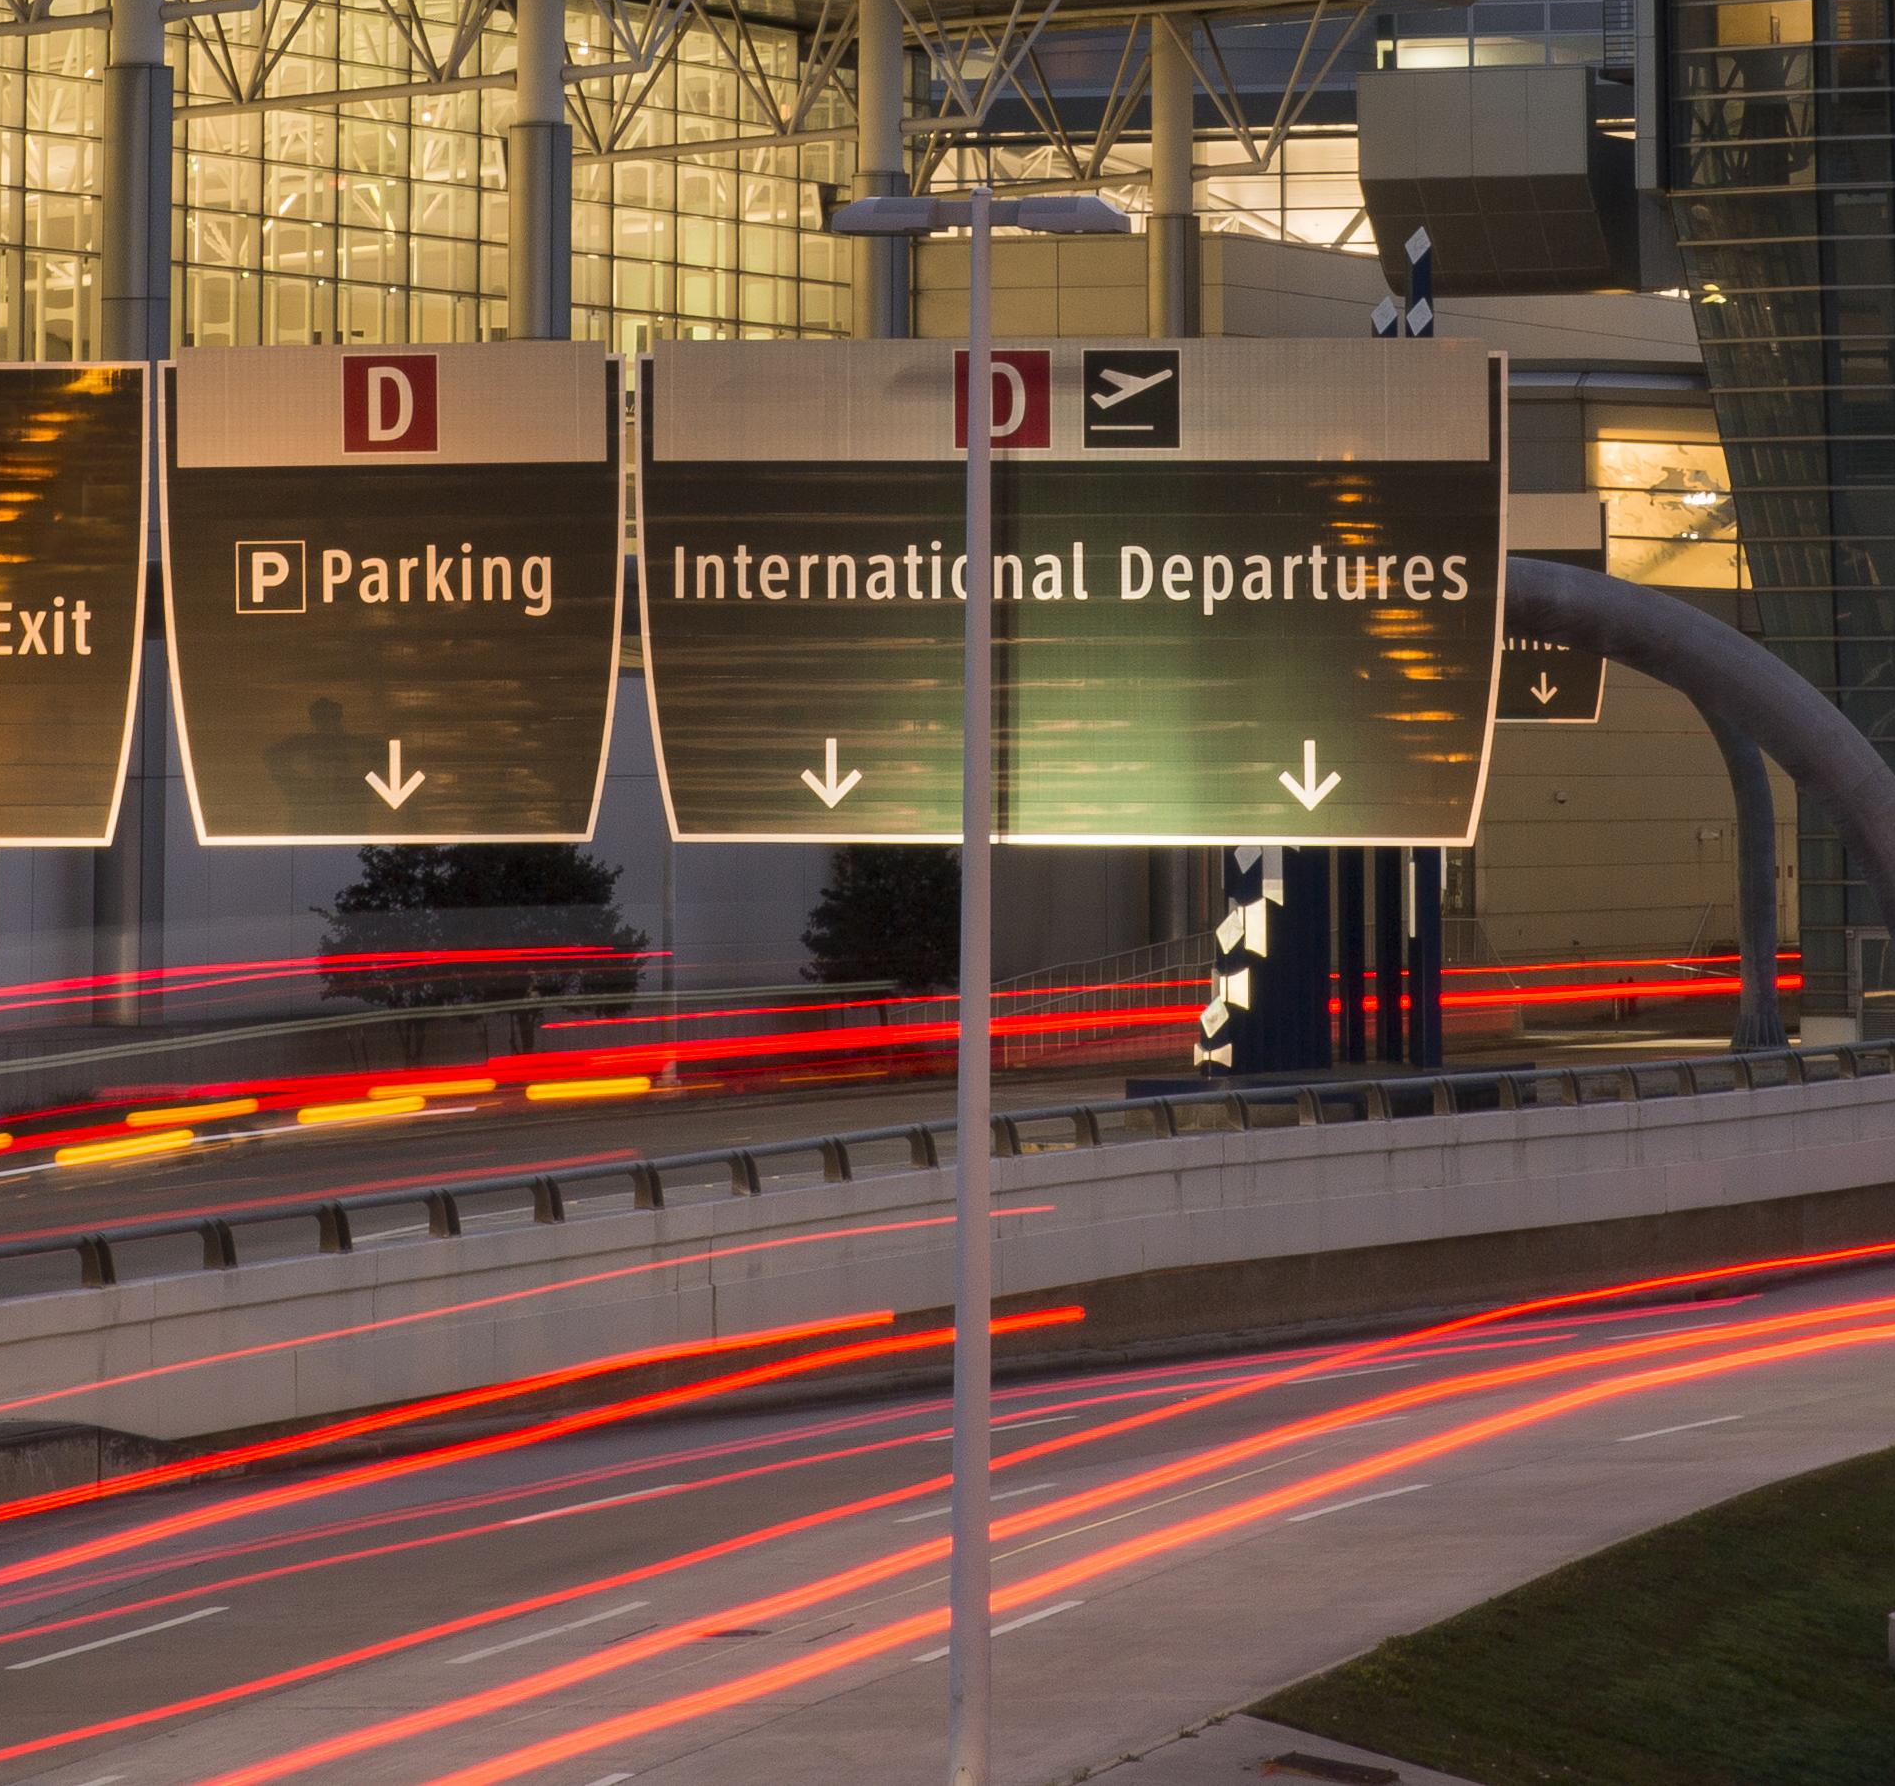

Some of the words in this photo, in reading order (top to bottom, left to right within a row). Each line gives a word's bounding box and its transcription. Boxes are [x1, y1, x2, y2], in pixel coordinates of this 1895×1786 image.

[367, 366, 414, 442] D
[988, 361, 1027, 438] D
[252, 551, 290, 603] P
[322, 542, 552, 617] Parking
[674, 540, 1088, 601] International
[1120, 544, 1469, 615] Departures
